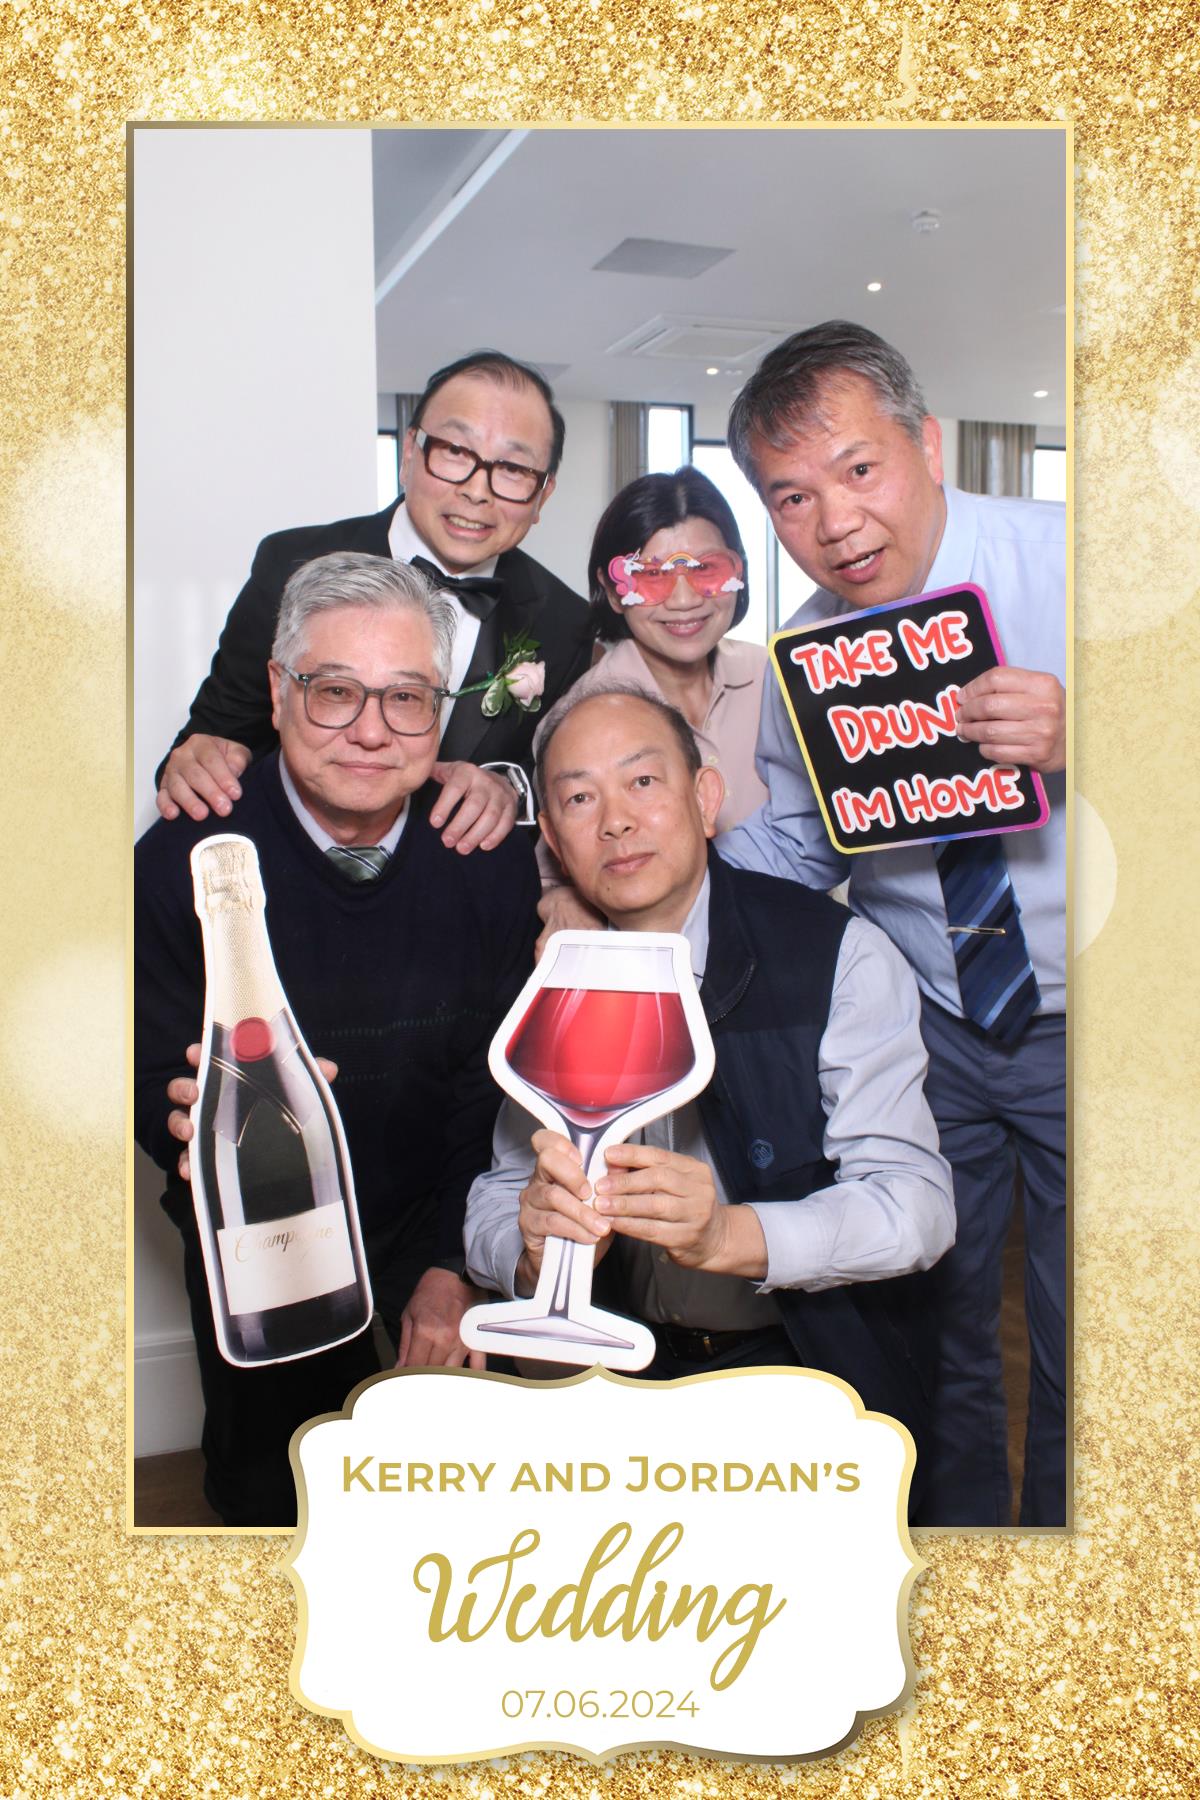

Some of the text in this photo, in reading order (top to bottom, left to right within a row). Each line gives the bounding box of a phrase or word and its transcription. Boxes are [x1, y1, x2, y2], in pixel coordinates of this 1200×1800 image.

[792, 612, 973, 693] TAKE ME
[832, 765, 1024, 833] I'M HOME
[235, 1227, 335, 1264] Campne
